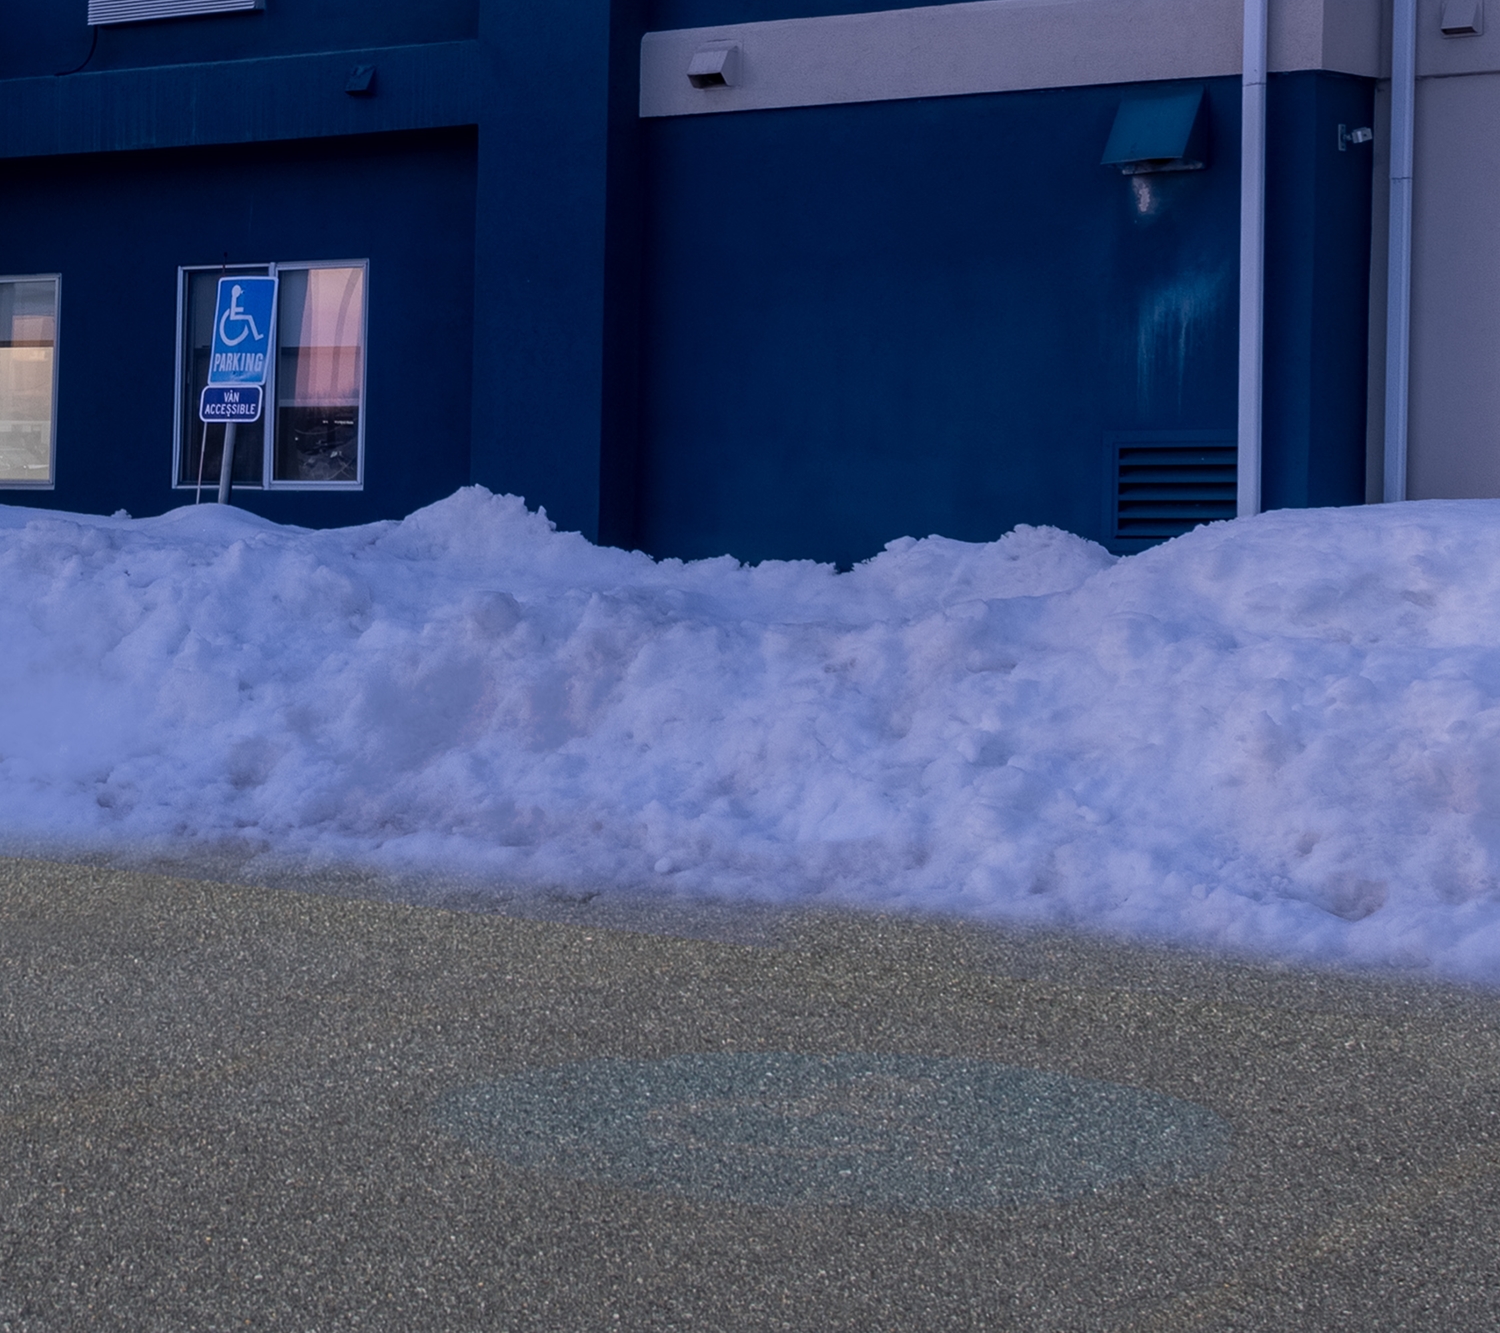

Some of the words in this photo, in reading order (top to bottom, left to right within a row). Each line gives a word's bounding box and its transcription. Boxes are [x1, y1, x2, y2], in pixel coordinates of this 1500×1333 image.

[213, 352, 264, 372] PARKING
[223, 391, 240, 403] VAN
[204, 403, 257, 415] ACCESSIBLE
